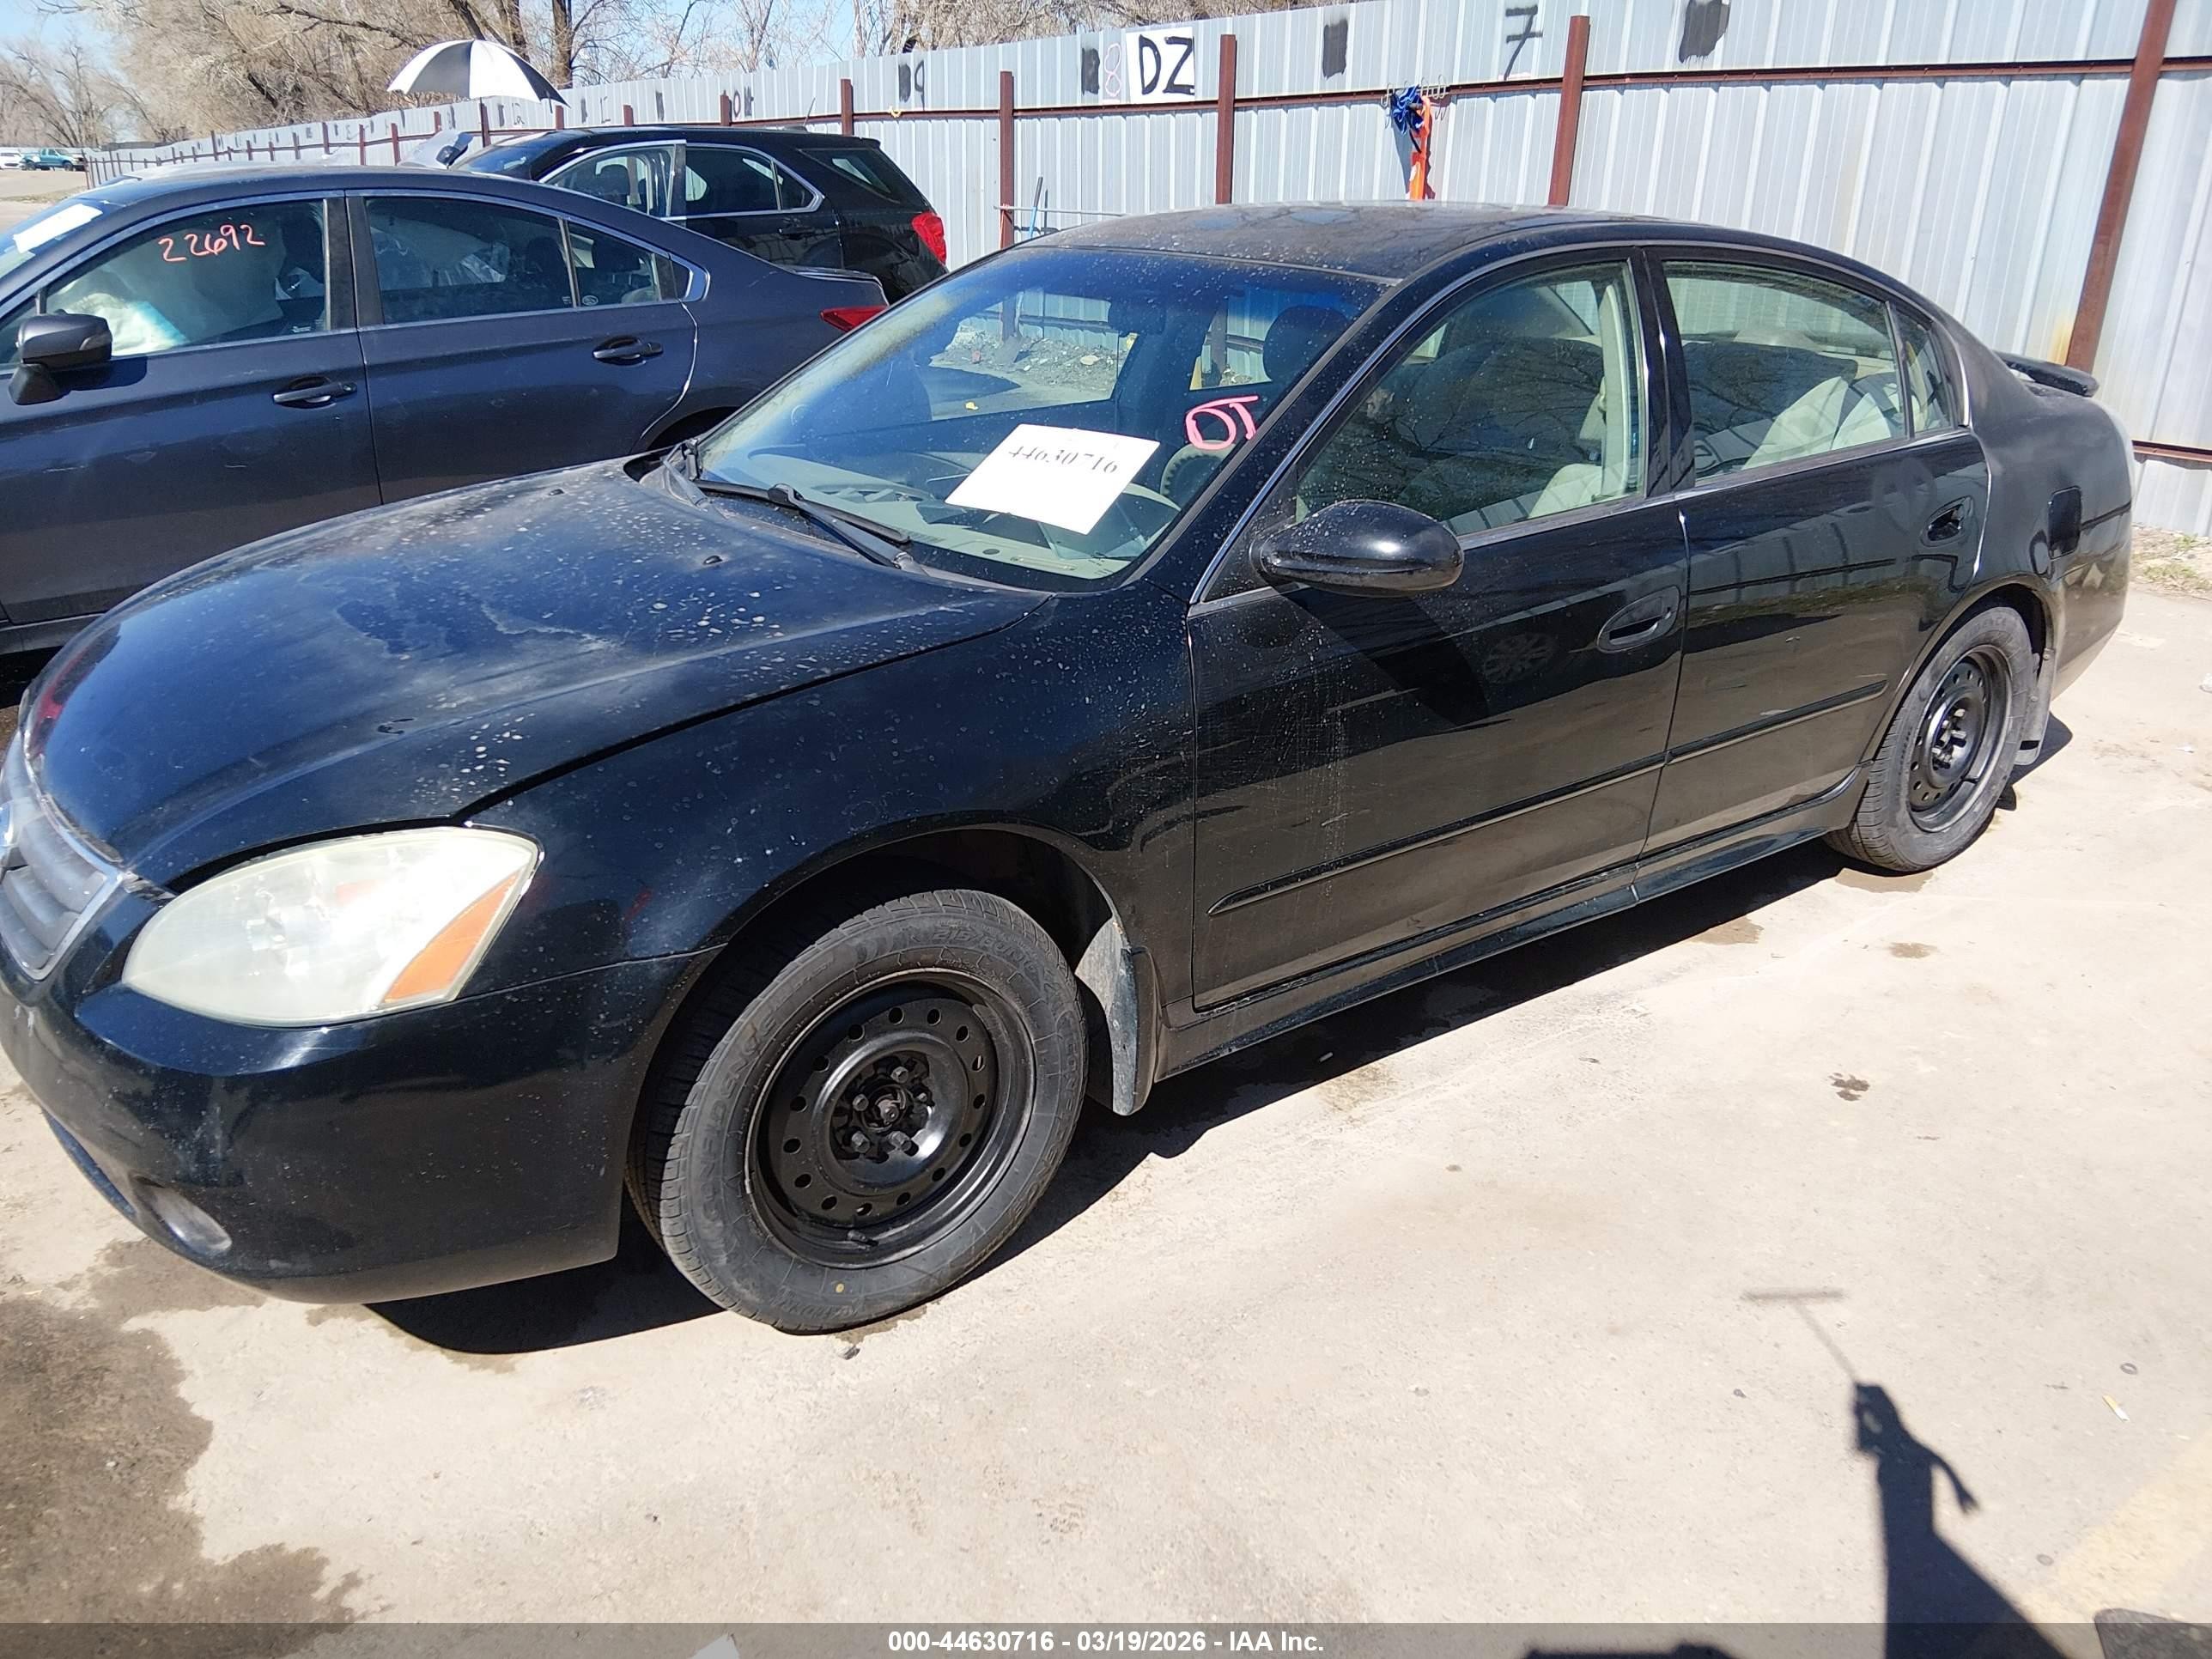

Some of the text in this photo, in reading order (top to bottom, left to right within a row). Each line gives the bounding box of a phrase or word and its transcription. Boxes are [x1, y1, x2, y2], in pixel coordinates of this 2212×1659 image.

[1138, 33, 1195, 95] DZ
[158, 224, 265, 262] 22692
[1008, 445, 1119, 474] 44630716
